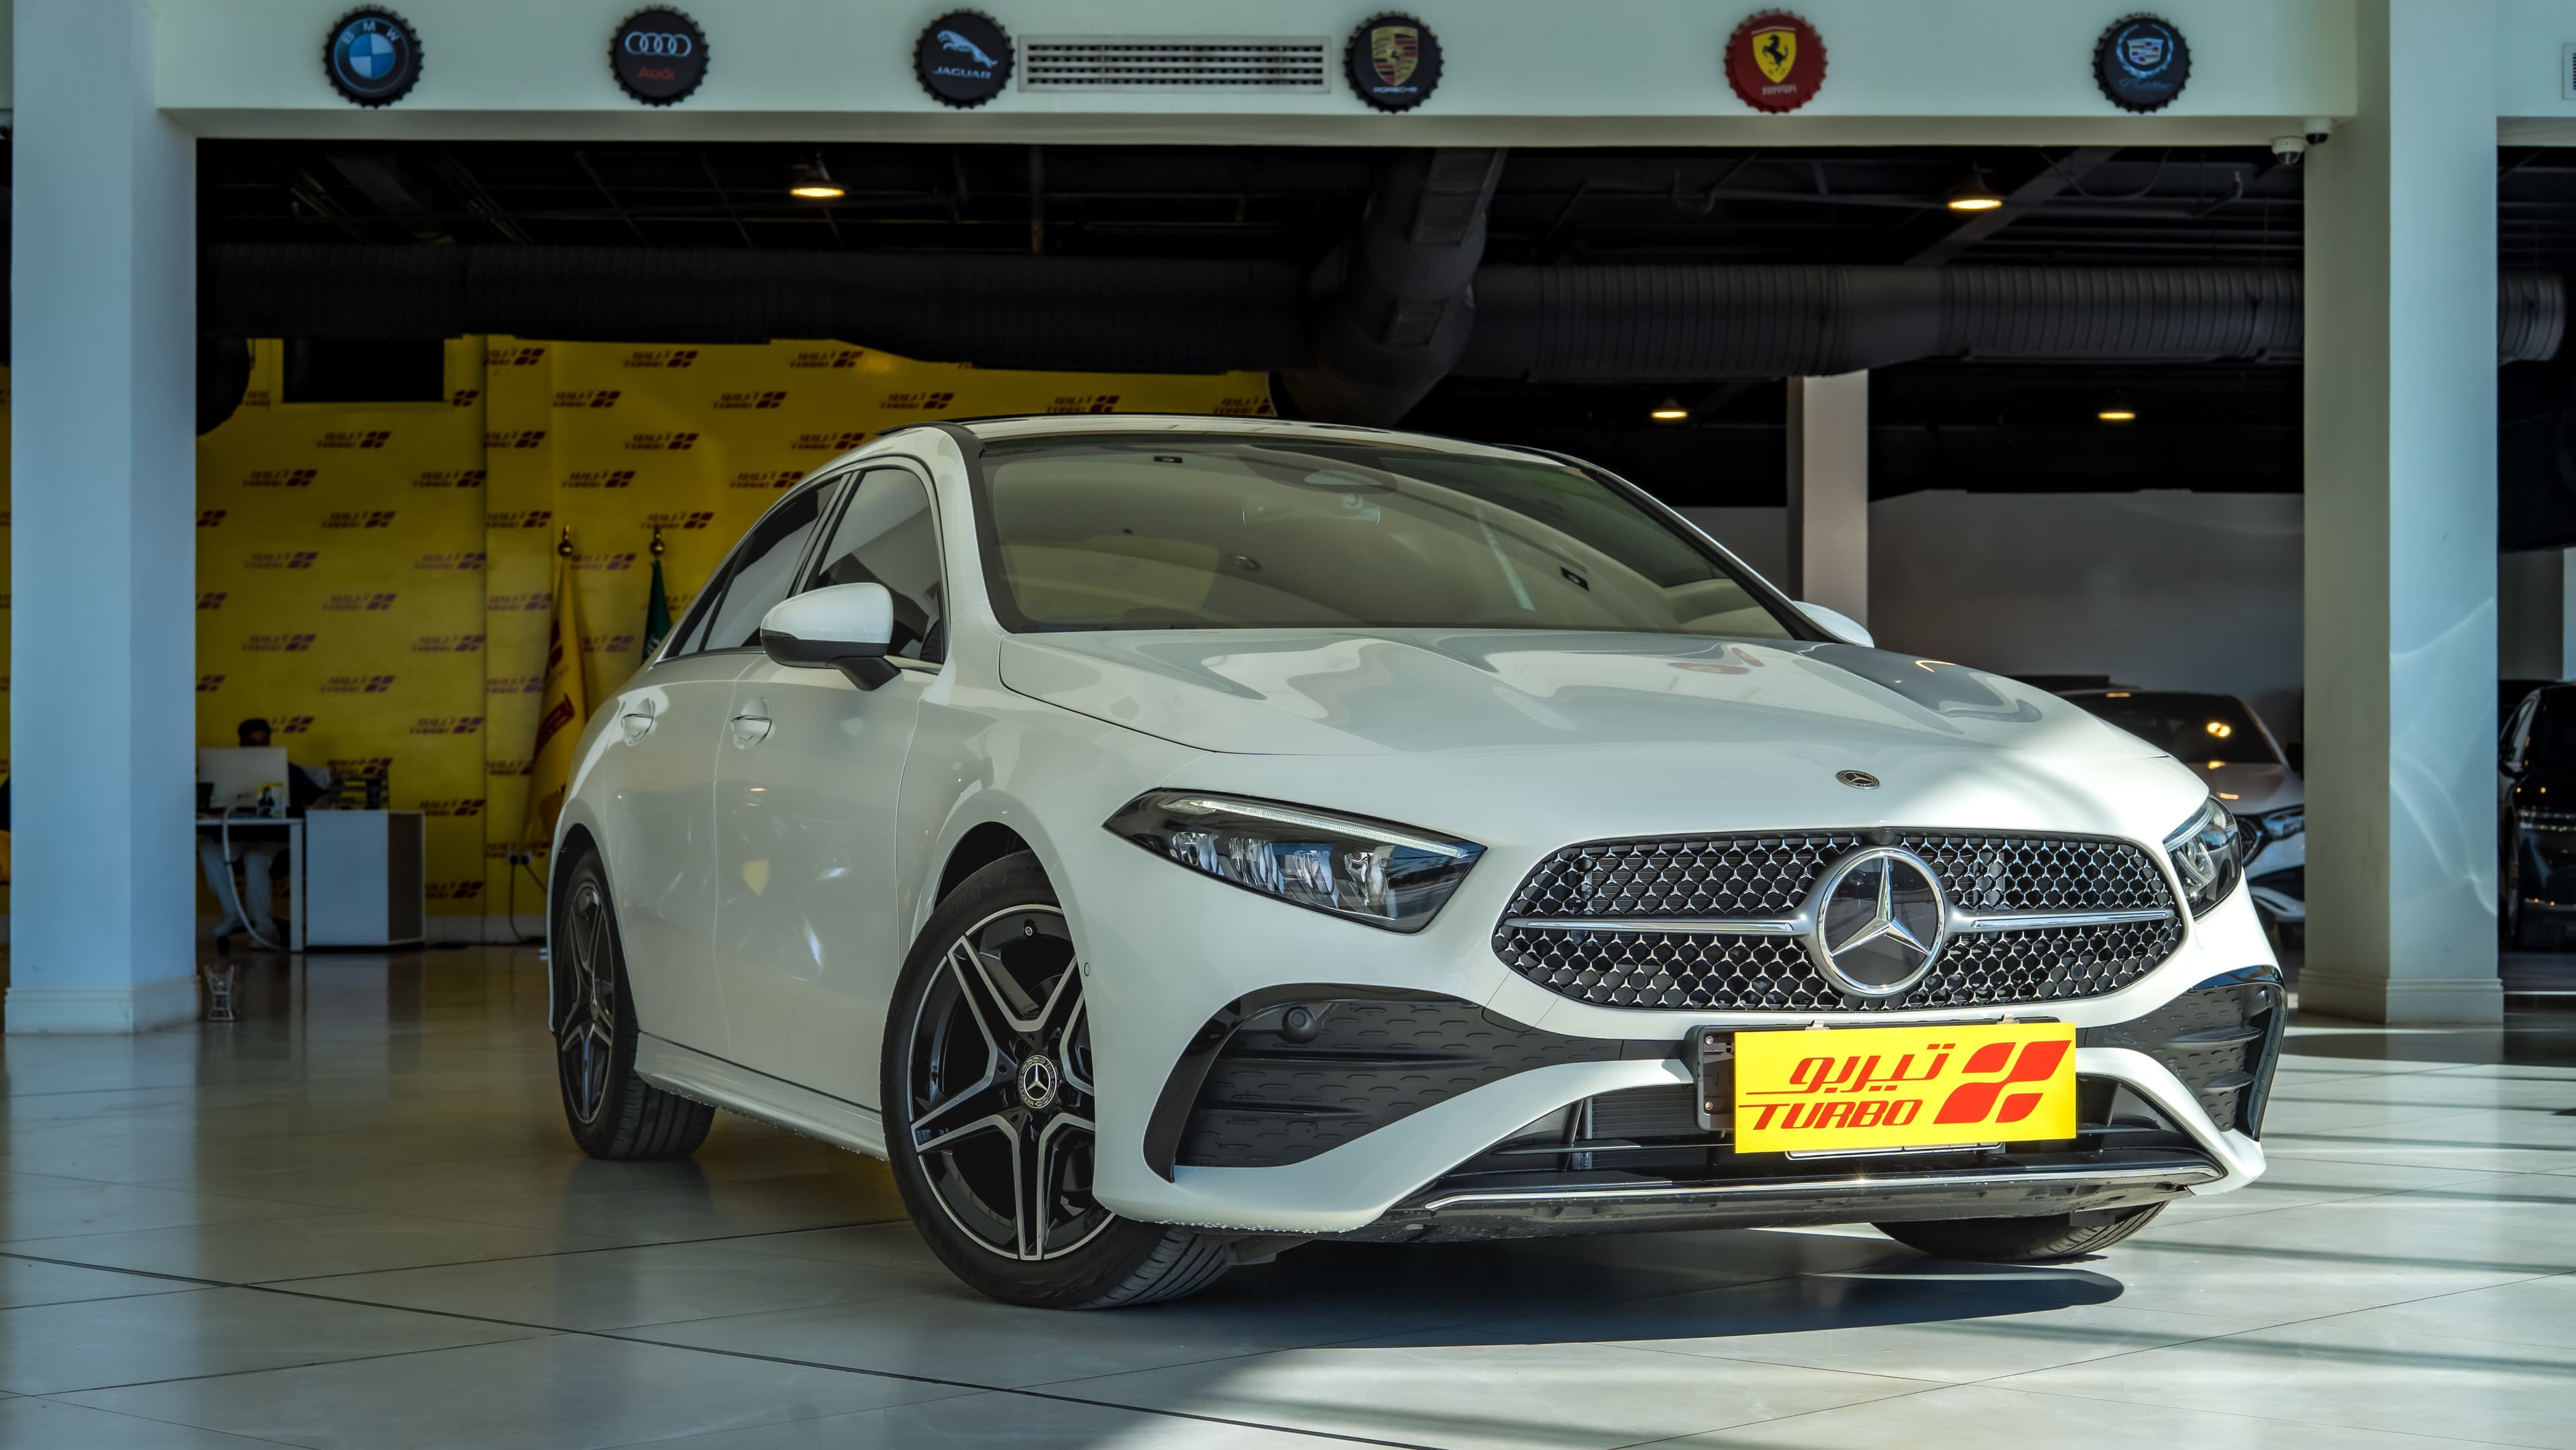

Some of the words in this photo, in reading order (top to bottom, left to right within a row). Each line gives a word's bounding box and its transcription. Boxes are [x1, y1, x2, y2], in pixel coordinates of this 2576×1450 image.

[341, 21, 400, 44] BMW
[638, 66, 676, 81] Audi
[932, 66, 991, 79] JAGUAR
[1738, 1099, 1923, 1130] TURBO
